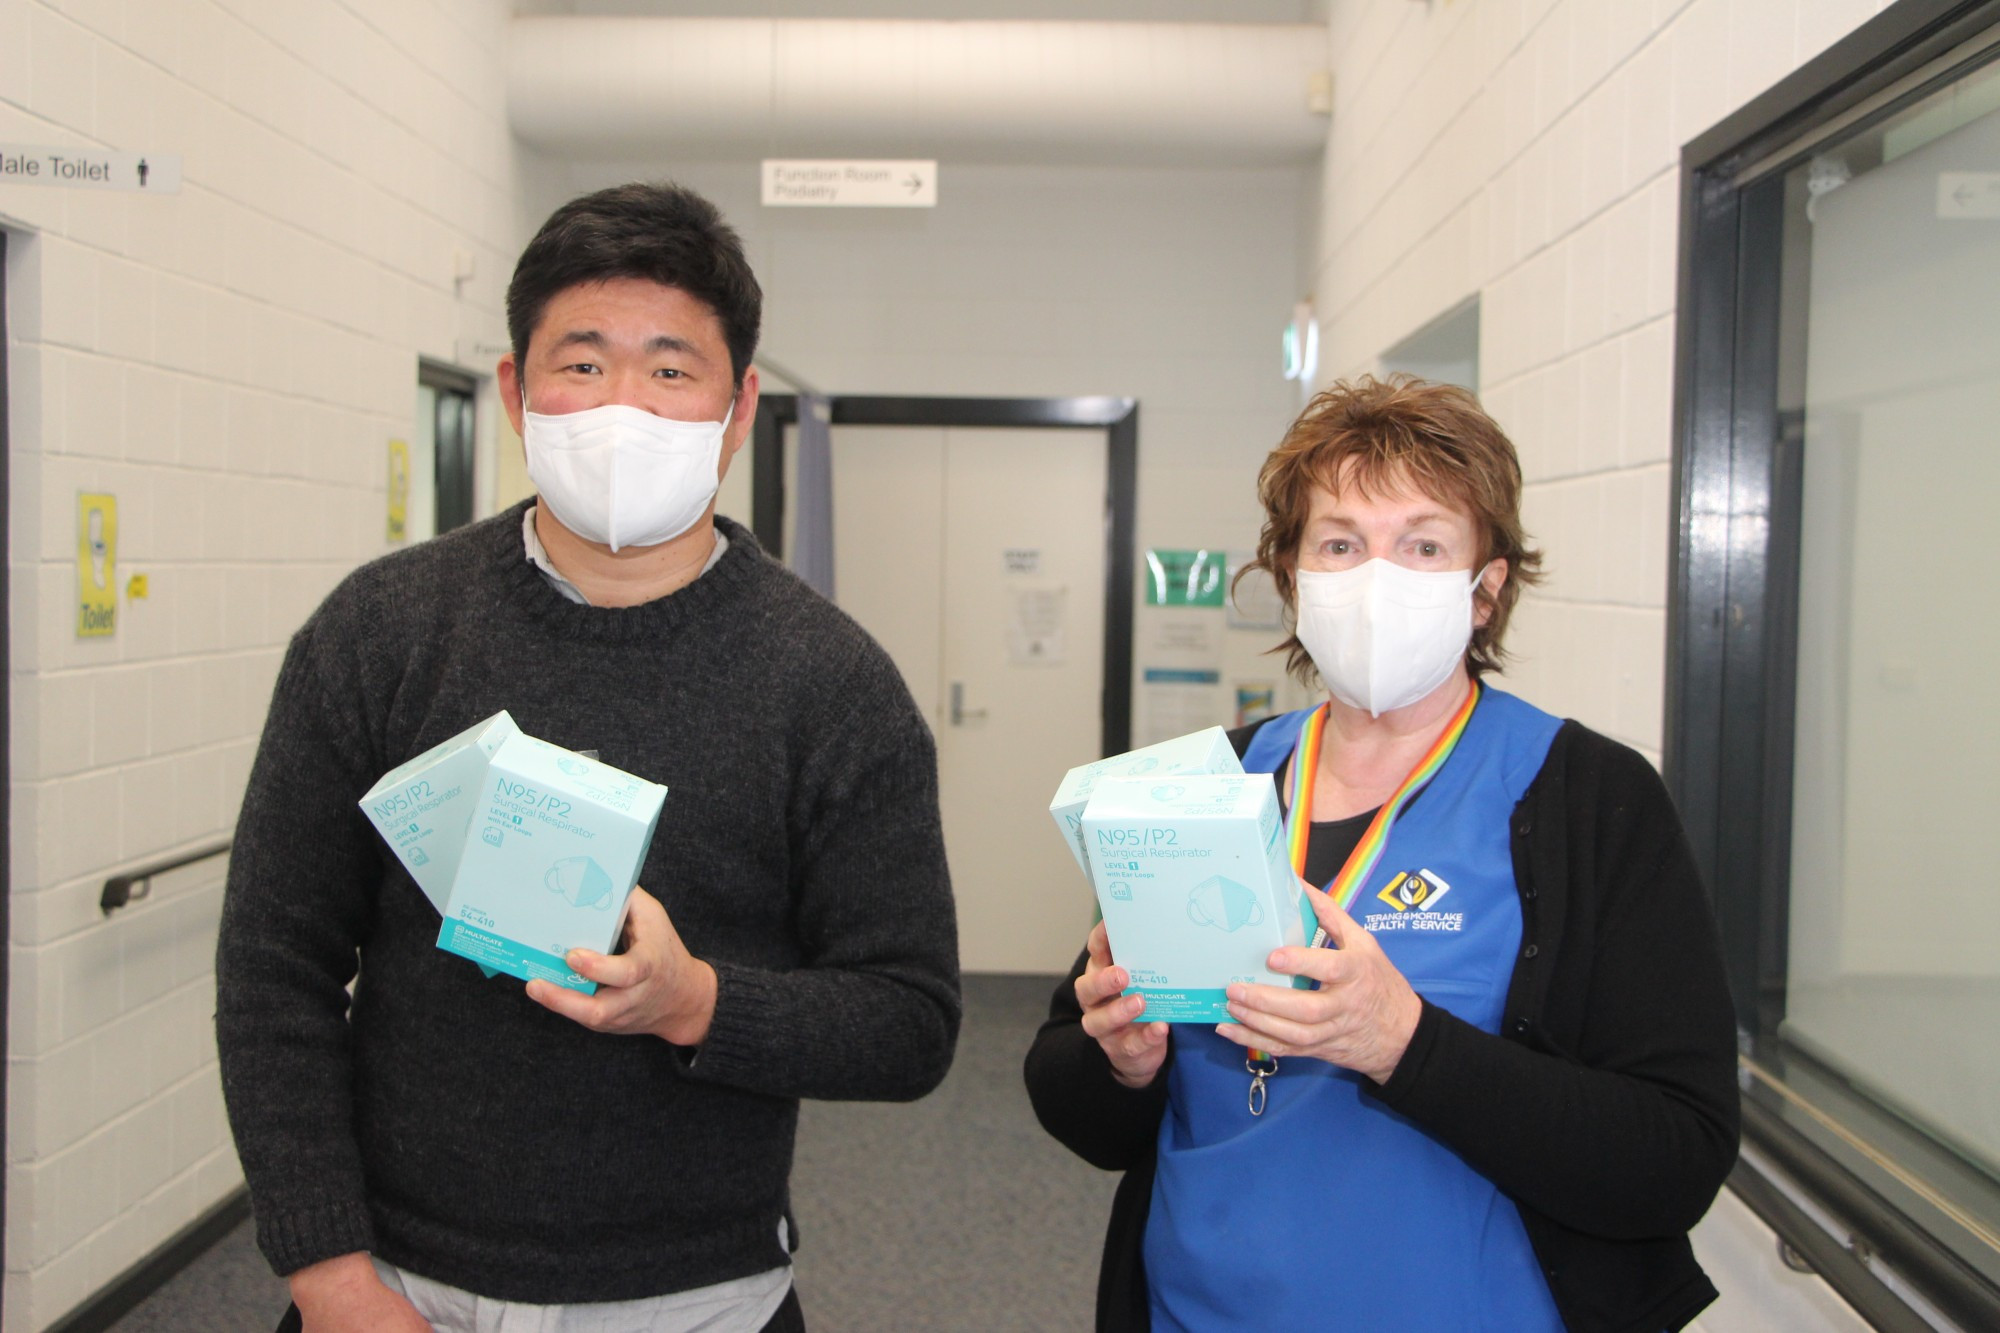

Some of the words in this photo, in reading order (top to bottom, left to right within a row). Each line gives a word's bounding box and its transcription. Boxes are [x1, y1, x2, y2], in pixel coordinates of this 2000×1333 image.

[0, 153, 39, 176] ale
[48, 155, 110, 181] Toilet
[844, 165, 892, 183] Room
[81, 603, 114, 630] Toilet
[373, 780, 435, 820] N95/P2
[497, 777, 572, 819] N95/P2
[490, 807, 511, 821] LEVEL
[493, 793, 537, 818] Surgical
[537, 811, 596, 840] Respirator
[1097, 828, 1178, 846] N95/P2
[1100, 848, 1147, 860] Surgical
[1149, 848, 1212, 860] Respirator
[461, 909, 495, 928] 54-410
[1364, 920, 1405, 931] HEALTH
[1412, 919, 1462, 931] SERVICE
[465, 929, 503, 947] MULTIGATE
[1131, 974, 1168, 984] 54-410
